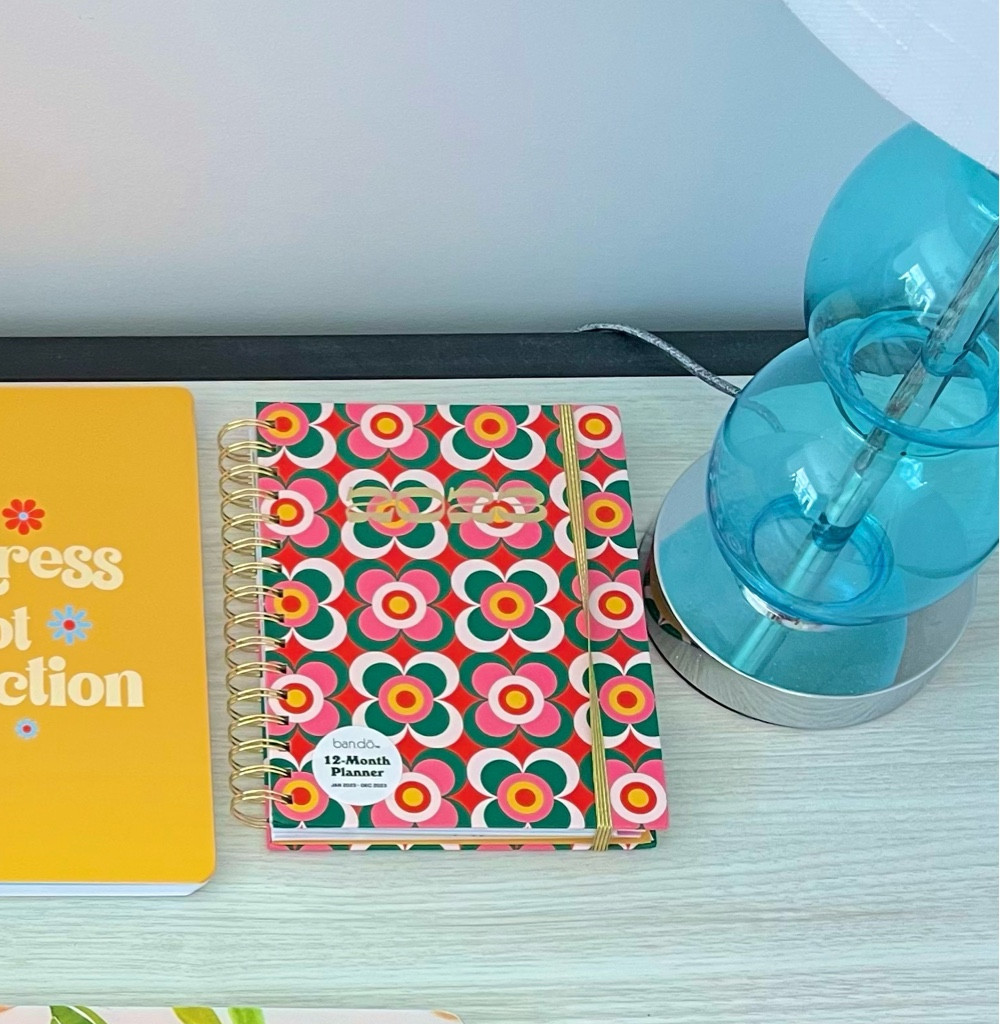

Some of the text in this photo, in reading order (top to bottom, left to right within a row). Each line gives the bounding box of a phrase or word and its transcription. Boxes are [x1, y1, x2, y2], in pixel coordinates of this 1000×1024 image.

[345, 486, 548, 523] 2023
[324, 755, 391, 766] 12-Month
[331, 767, 385, 777] Planner
